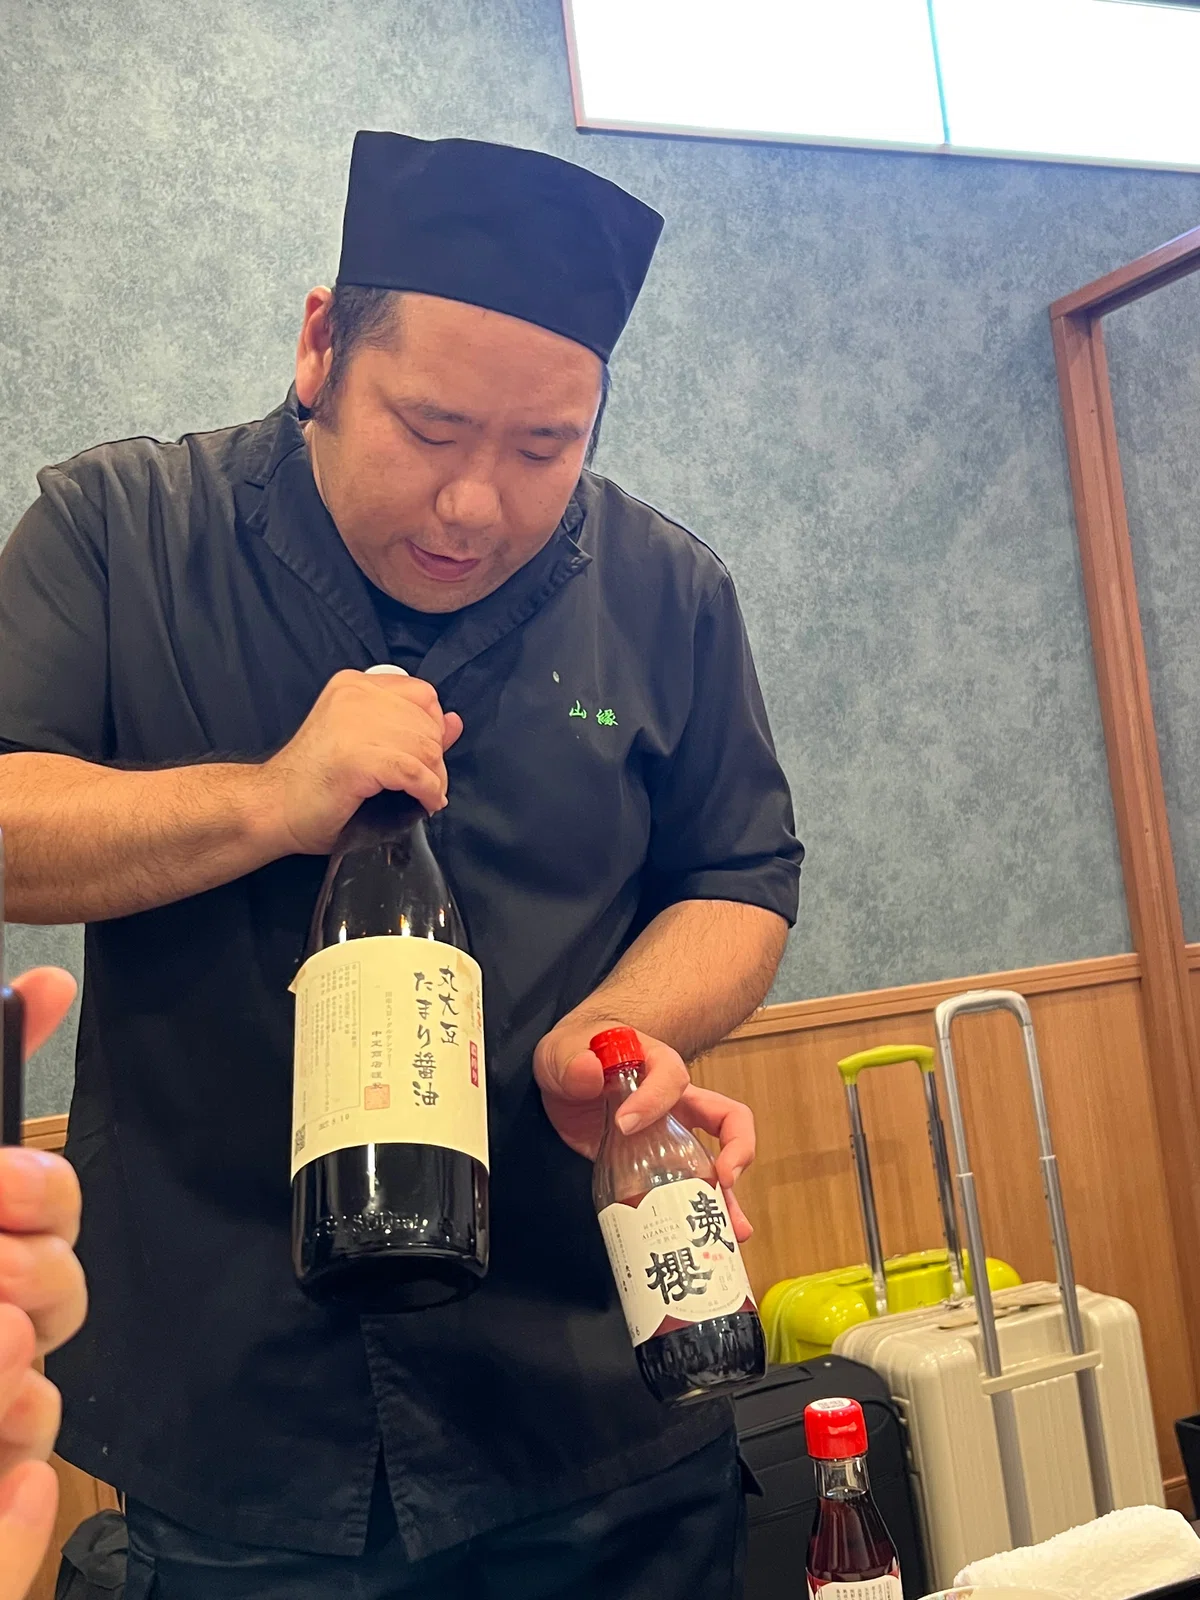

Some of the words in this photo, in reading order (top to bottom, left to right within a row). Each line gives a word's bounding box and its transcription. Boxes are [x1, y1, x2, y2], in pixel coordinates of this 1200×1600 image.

[438, 964, 460, 1047] 丸大豆
[642, 1224, 681, 1241] AIZAKURA
